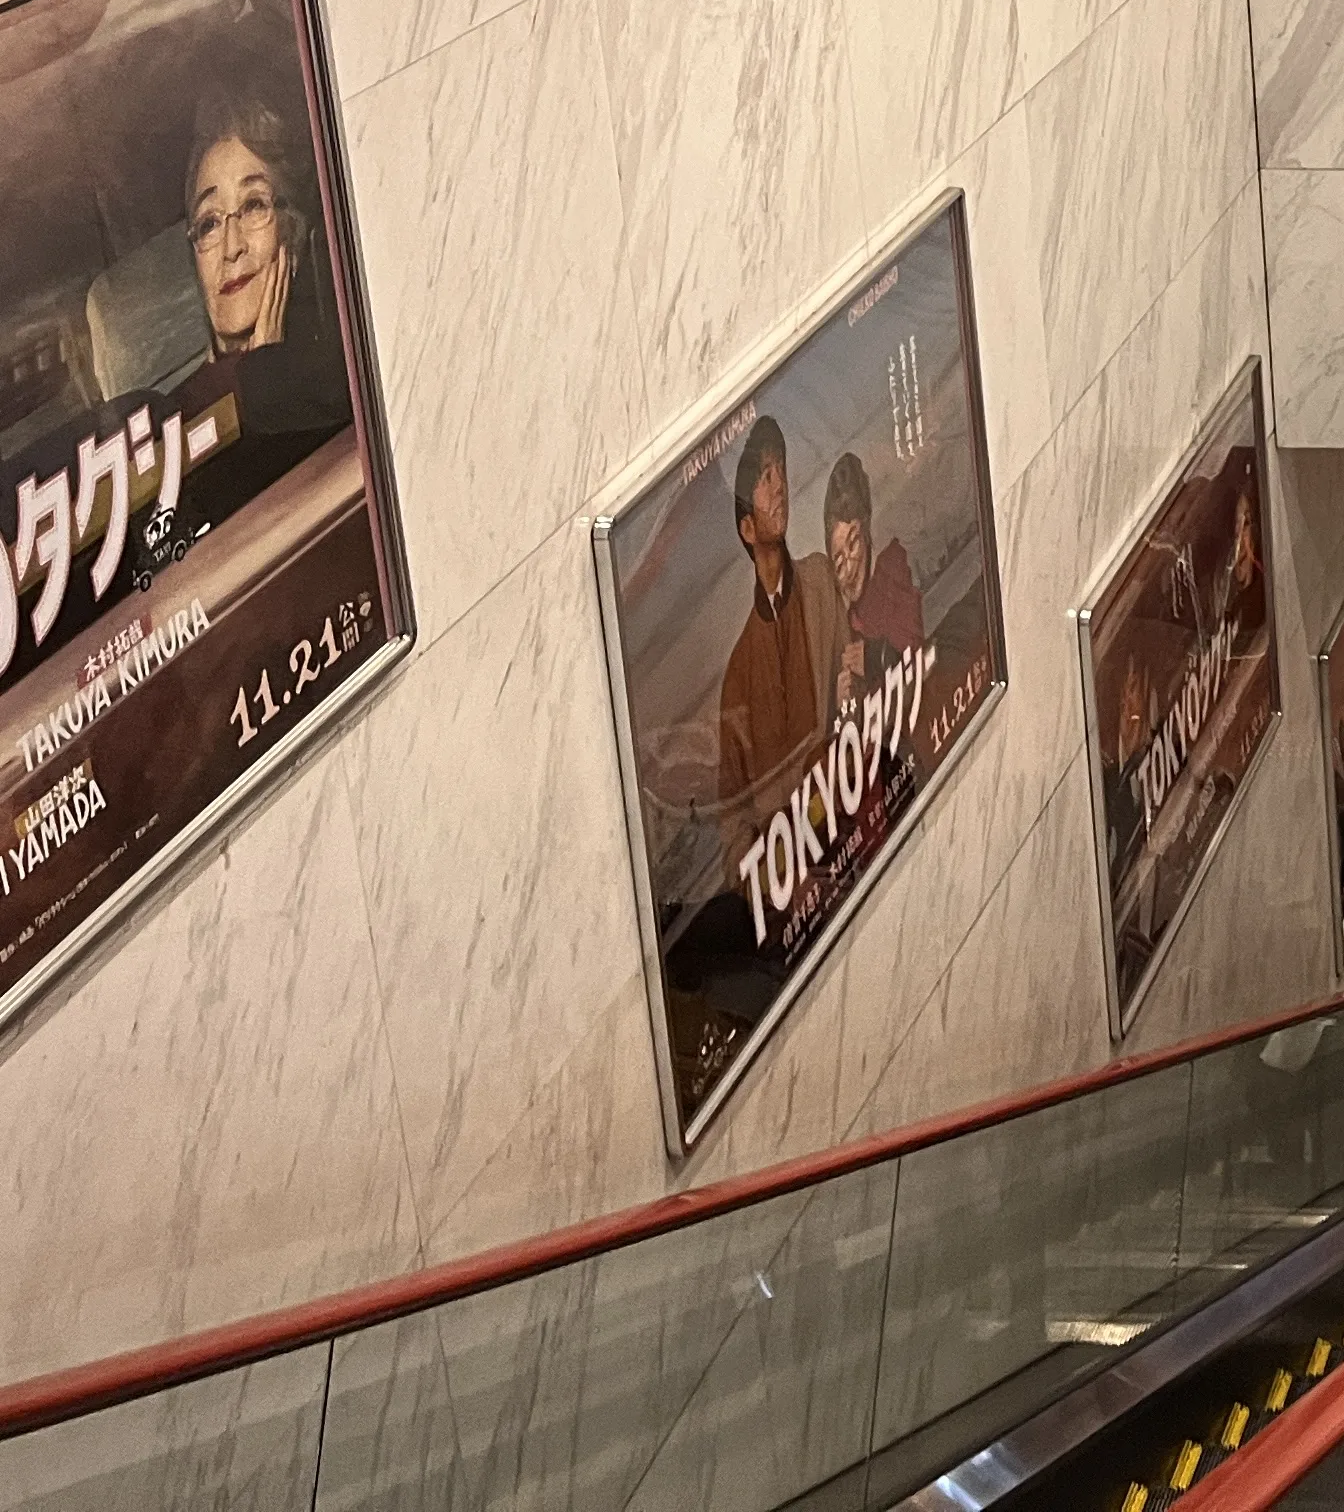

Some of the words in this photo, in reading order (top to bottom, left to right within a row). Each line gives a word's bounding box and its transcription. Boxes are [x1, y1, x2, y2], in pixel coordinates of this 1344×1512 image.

[16, 678, 112, 773] TAKUYA
[116, 597, 211, 696] KIMURA
[83, 618, 145, 682] 木村拓哉
[229, 616, 343, 748] 11.21
[9, 779, 107, 881] YAMADA
[24, 765, 88, 833] 山田洋次
